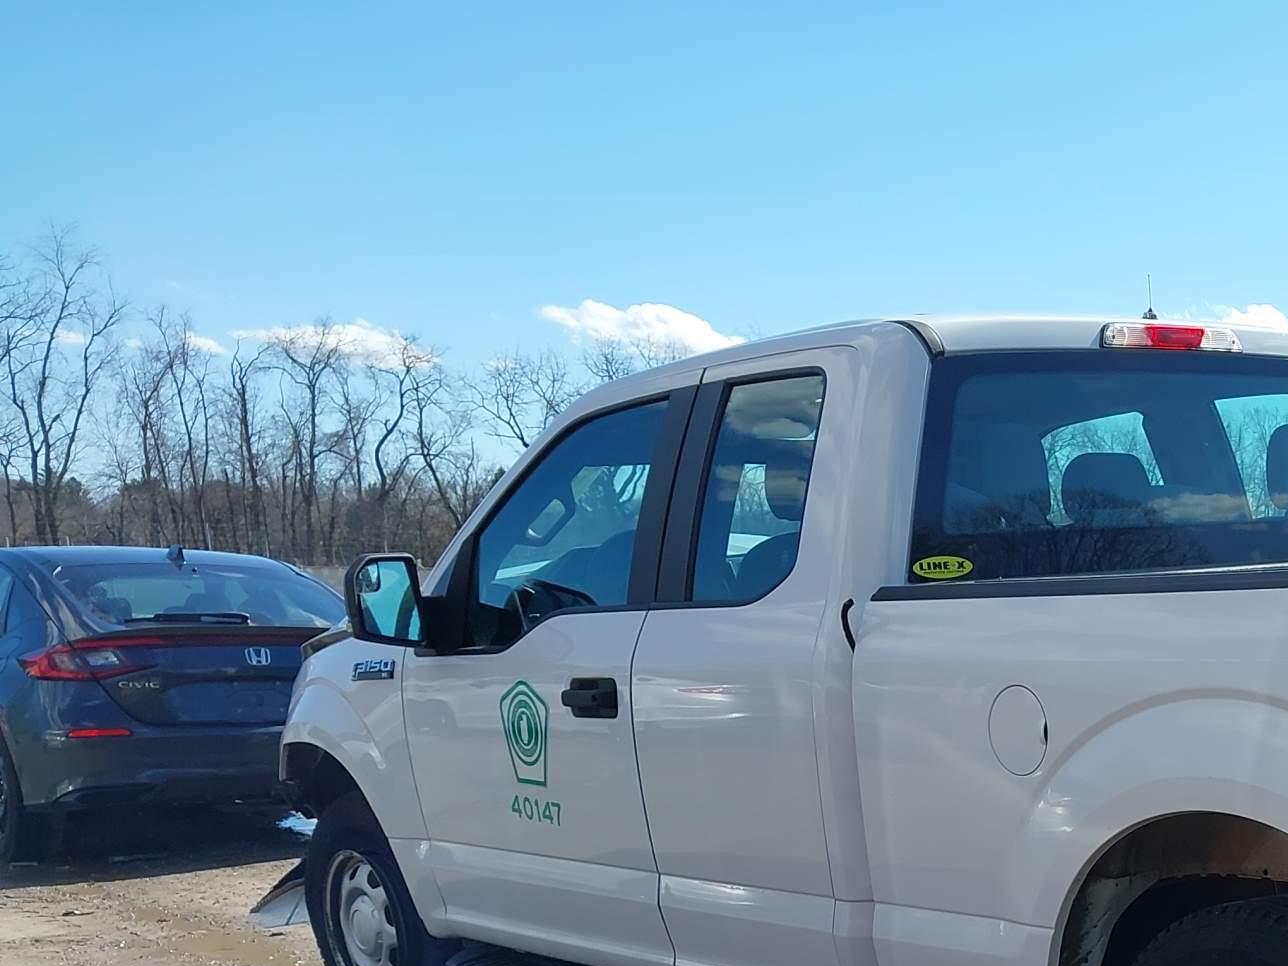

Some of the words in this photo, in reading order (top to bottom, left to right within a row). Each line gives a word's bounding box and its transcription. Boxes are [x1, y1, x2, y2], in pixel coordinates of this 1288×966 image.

[918, 560, 967, 572] LINE-X
[118, 681, 160, 689] CIVIC
[511, 794, 561, 827] 40147
